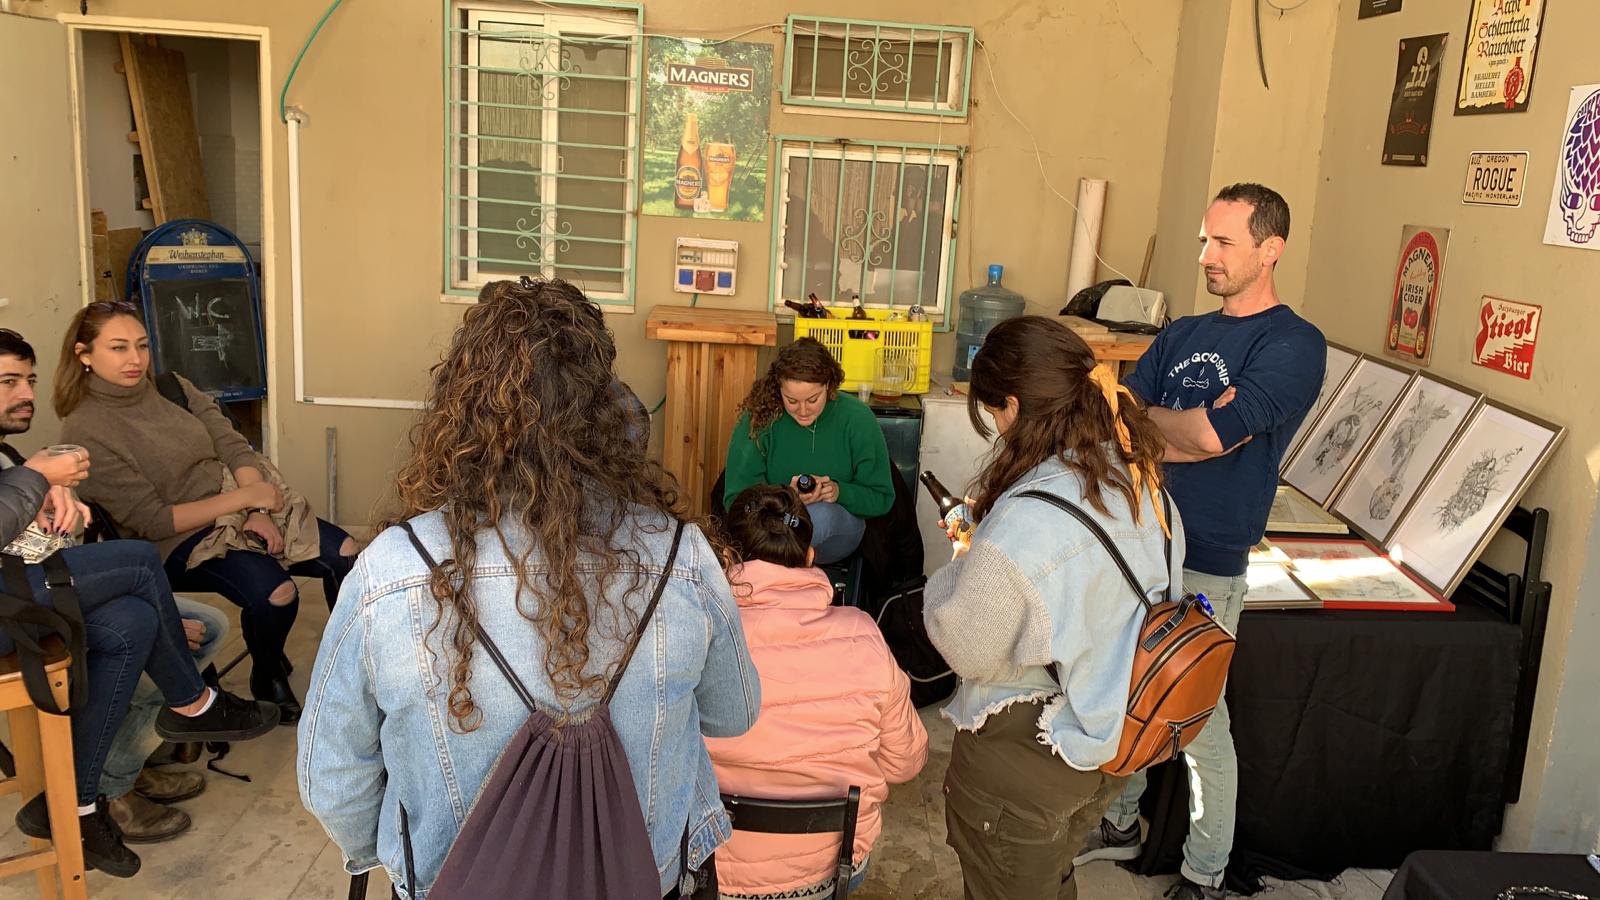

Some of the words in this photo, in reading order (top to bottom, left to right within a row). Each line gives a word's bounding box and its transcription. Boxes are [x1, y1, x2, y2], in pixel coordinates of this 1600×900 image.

[1477, 37, 1526, 57] Rauchbier
[670, 66, 750, 88] MAGNERS
[1474, 81, 1496, 90] HELLER
[1487, 155, 1510, 163] OREGON
[1472, 167, 1518, 192] ROGUE
[1485, 193, 1520, 201] WONDERLAND
[1403, 292, 1423, 306] CIDER
[1405, 283, 1424, 296] IRISH
[1476, 301, 1537, 362] Stiegl
[1167, 358, 1191, 378] THE
[1191, 352, 1230, 387] GODSHIP
[1502, 352, 1530, 375] Bier
